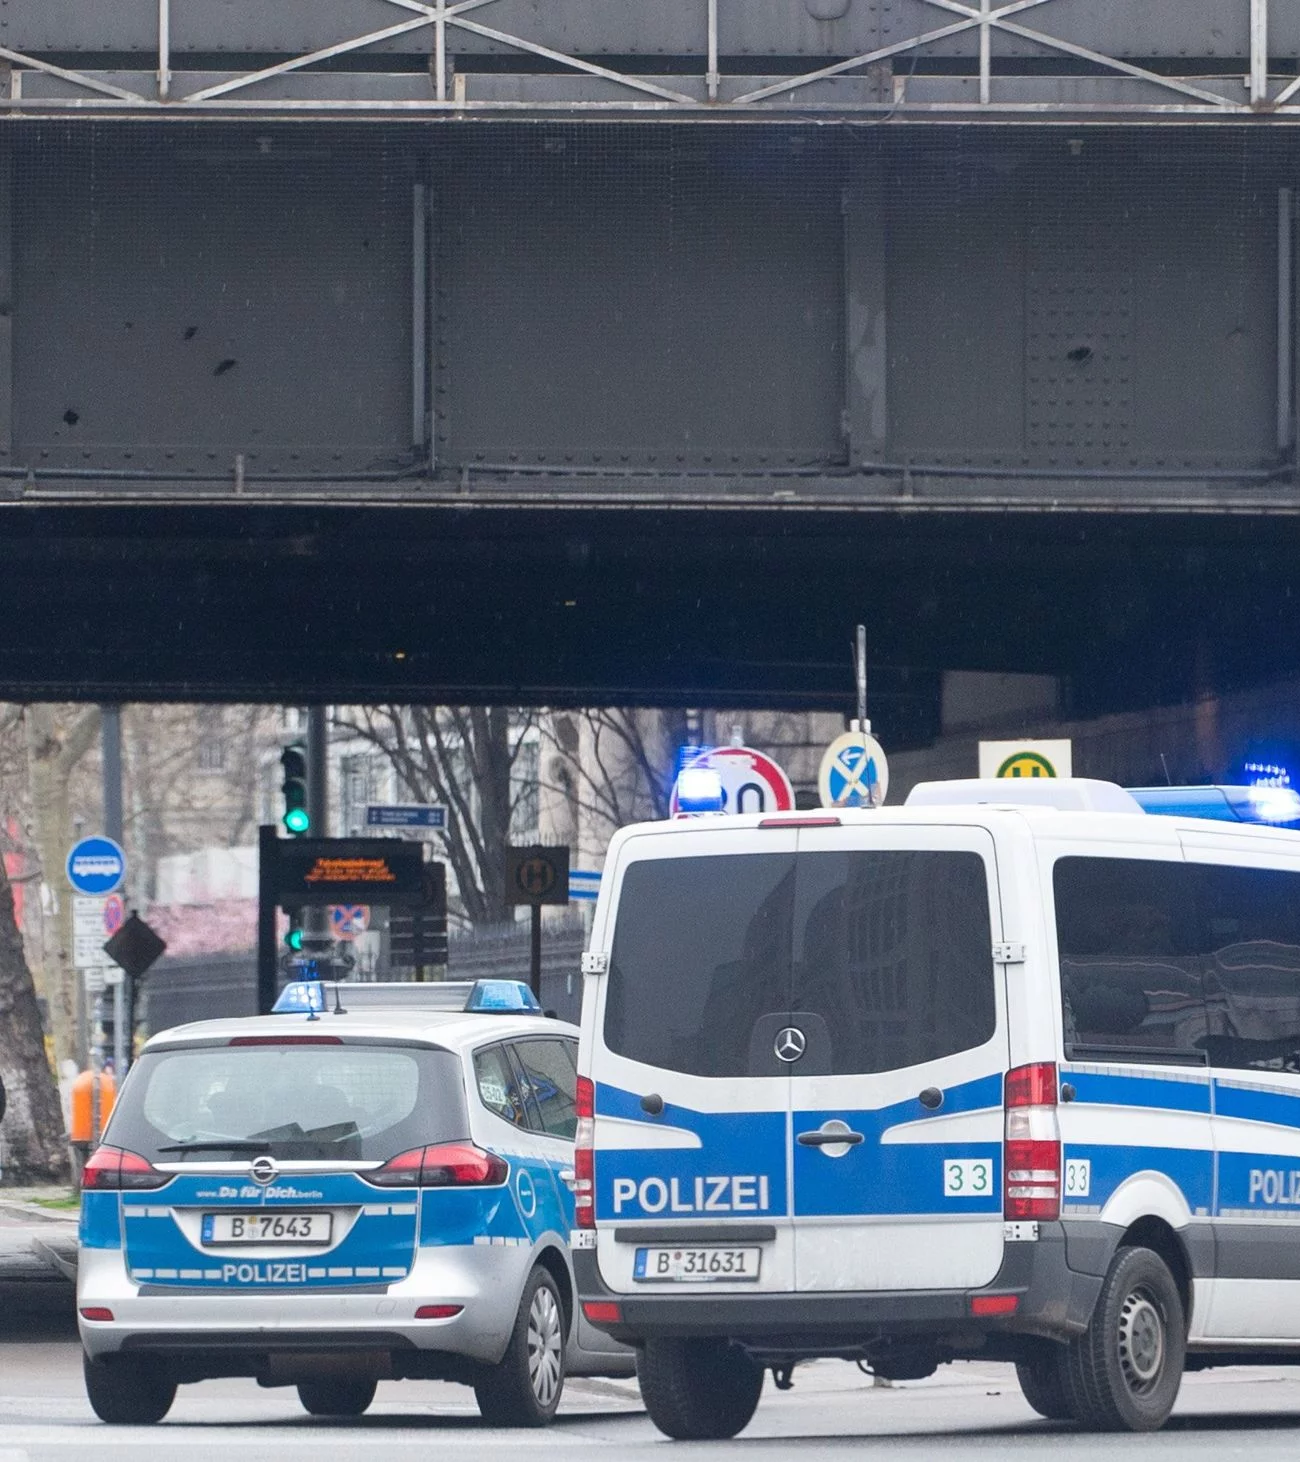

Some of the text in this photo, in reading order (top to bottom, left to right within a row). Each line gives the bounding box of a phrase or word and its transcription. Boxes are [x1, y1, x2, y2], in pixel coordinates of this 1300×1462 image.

[240, 1186, 261, 1198] für
[265, 1186, 323, 1198] Dich.berlin
[613, 1175, 769, 1213] POLIZEI
[231, 1217, 313, 1238] B 7643
[657, 1251, 746, 1273] B 31631
[223, 1264, 306, 1283] POLIZEI
